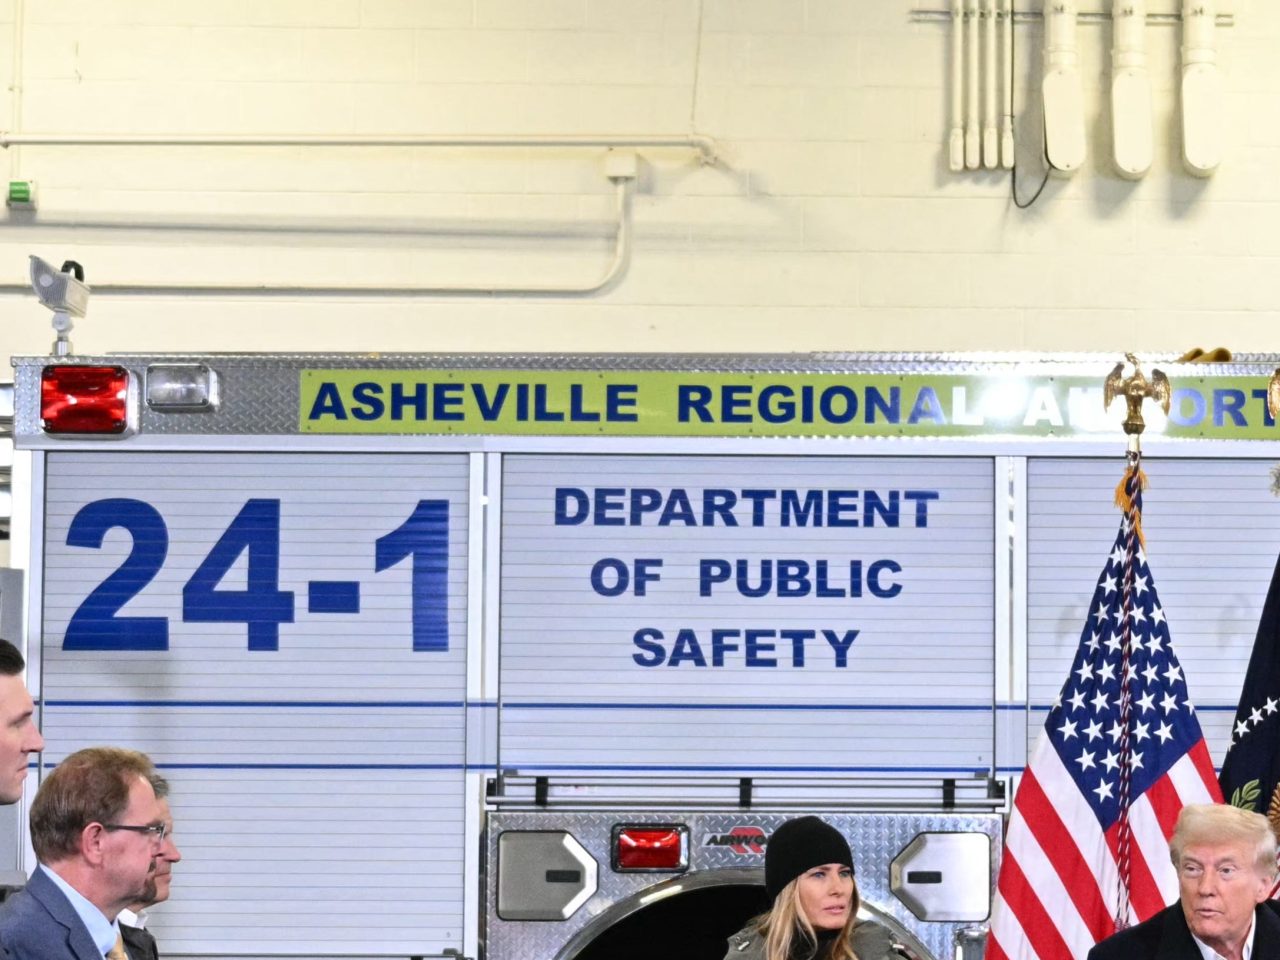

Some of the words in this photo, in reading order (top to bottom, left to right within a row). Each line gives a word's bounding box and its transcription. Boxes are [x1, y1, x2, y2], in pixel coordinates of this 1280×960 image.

[311, 383, 638, 423] ASHEVILLE
[678, 385, 985, 426] REGIONAL
[1022, 386, 1277, 428] AORT
[554, 487, 940, 529] DEPARTMENT
[62, 497, 450, 653] 24-1
[589, 557, 664, 598] OF
[699, 558, 904, 599] PUBLIC
[631, 627, 860, 669] SAFETY
[705, 835, 769, 846] AIRWO
